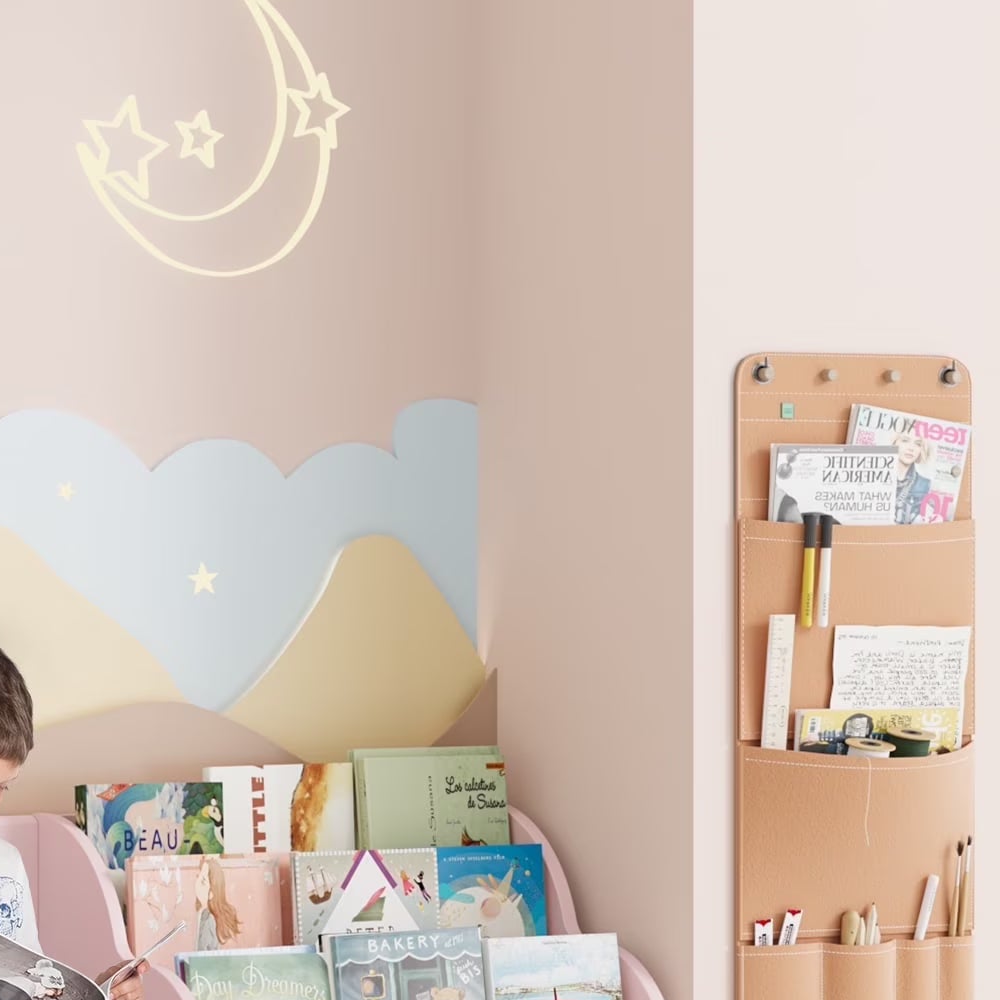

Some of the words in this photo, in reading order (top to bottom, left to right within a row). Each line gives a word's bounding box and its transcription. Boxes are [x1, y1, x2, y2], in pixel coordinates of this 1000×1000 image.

[445, 776, 463, 794] Los
[467, 795, 476, 809] de
[477, 793, 506, 809] Susana
[368, 935, 440, 953] BAKERY
